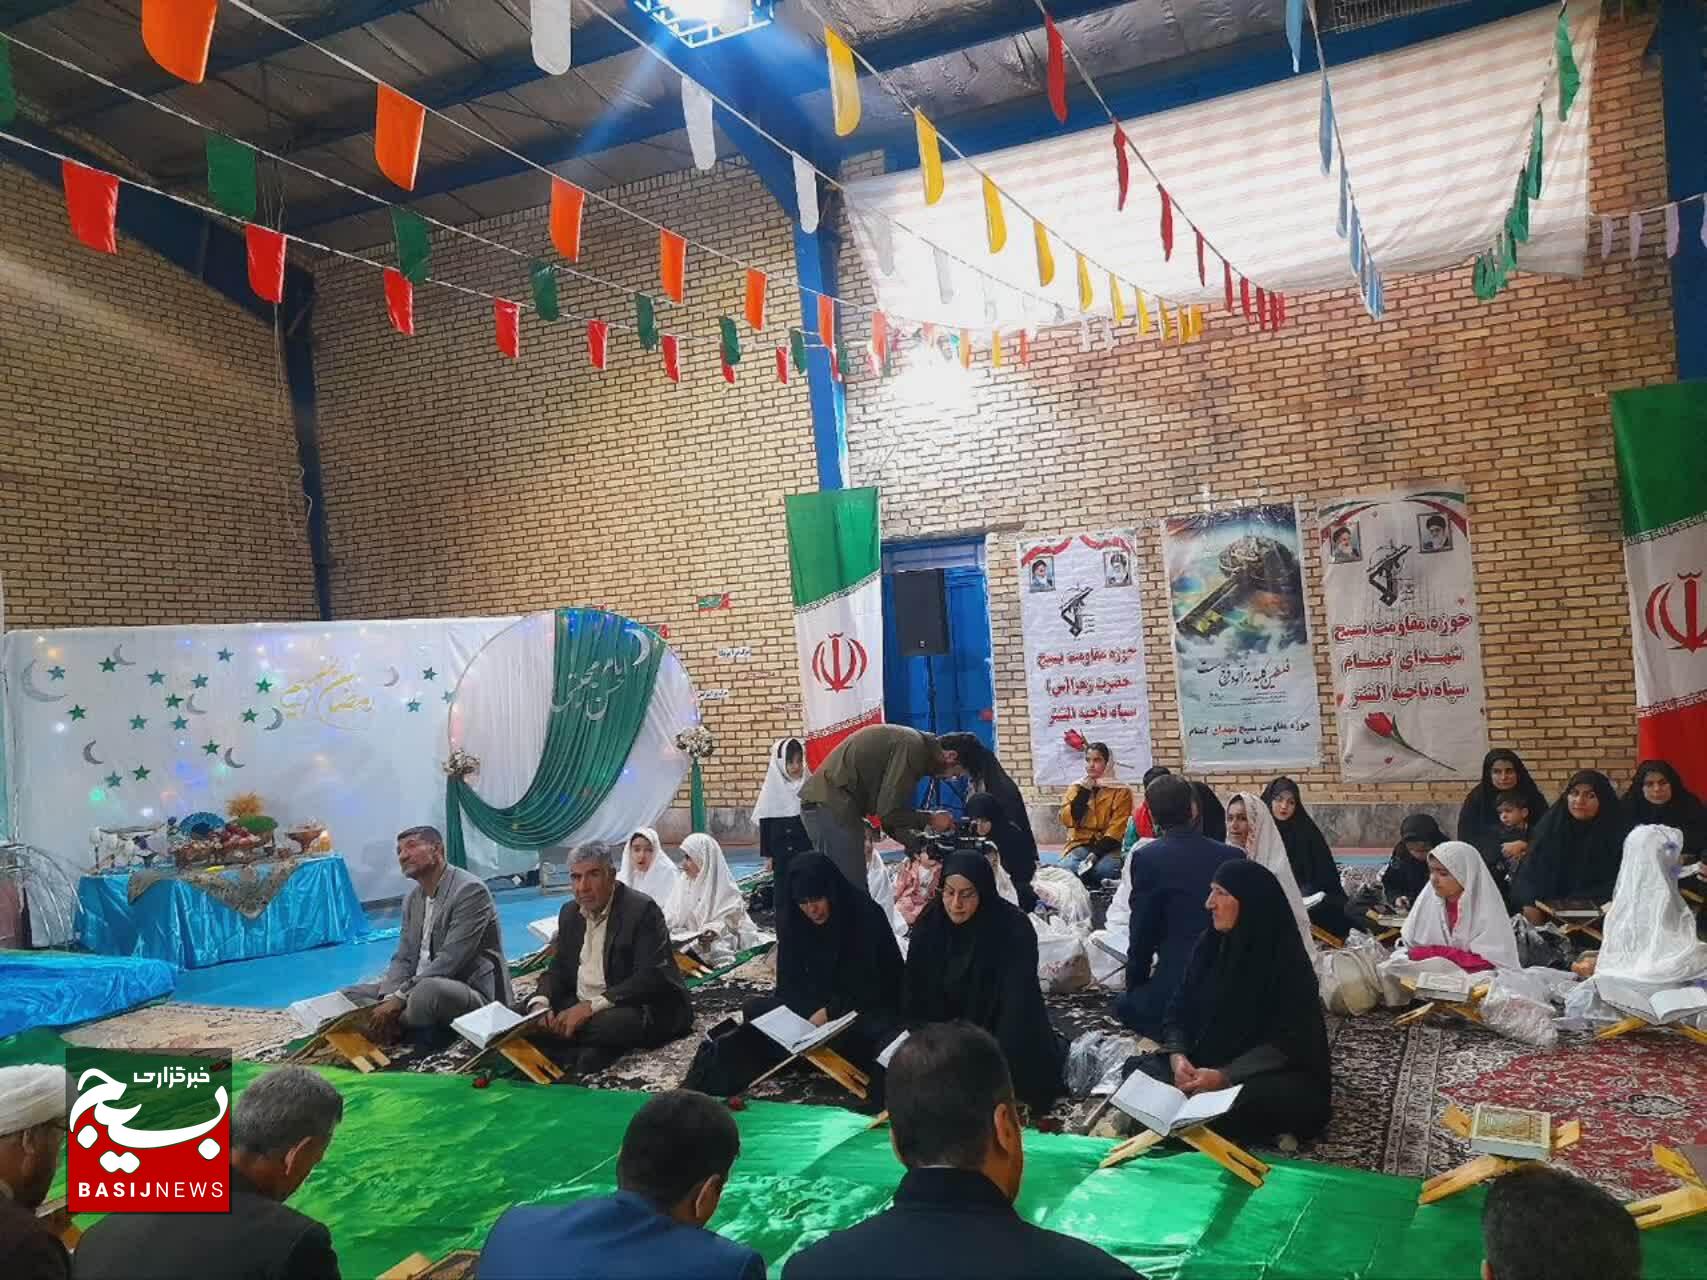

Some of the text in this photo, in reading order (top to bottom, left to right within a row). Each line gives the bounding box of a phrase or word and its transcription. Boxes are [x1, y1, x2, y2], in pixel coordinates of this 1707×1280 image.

[1332, 622, 1368, 642] بسیج
[1429, 613, 1472, 636] حوزه
[1400, 645, 1464, 671] شهدای
